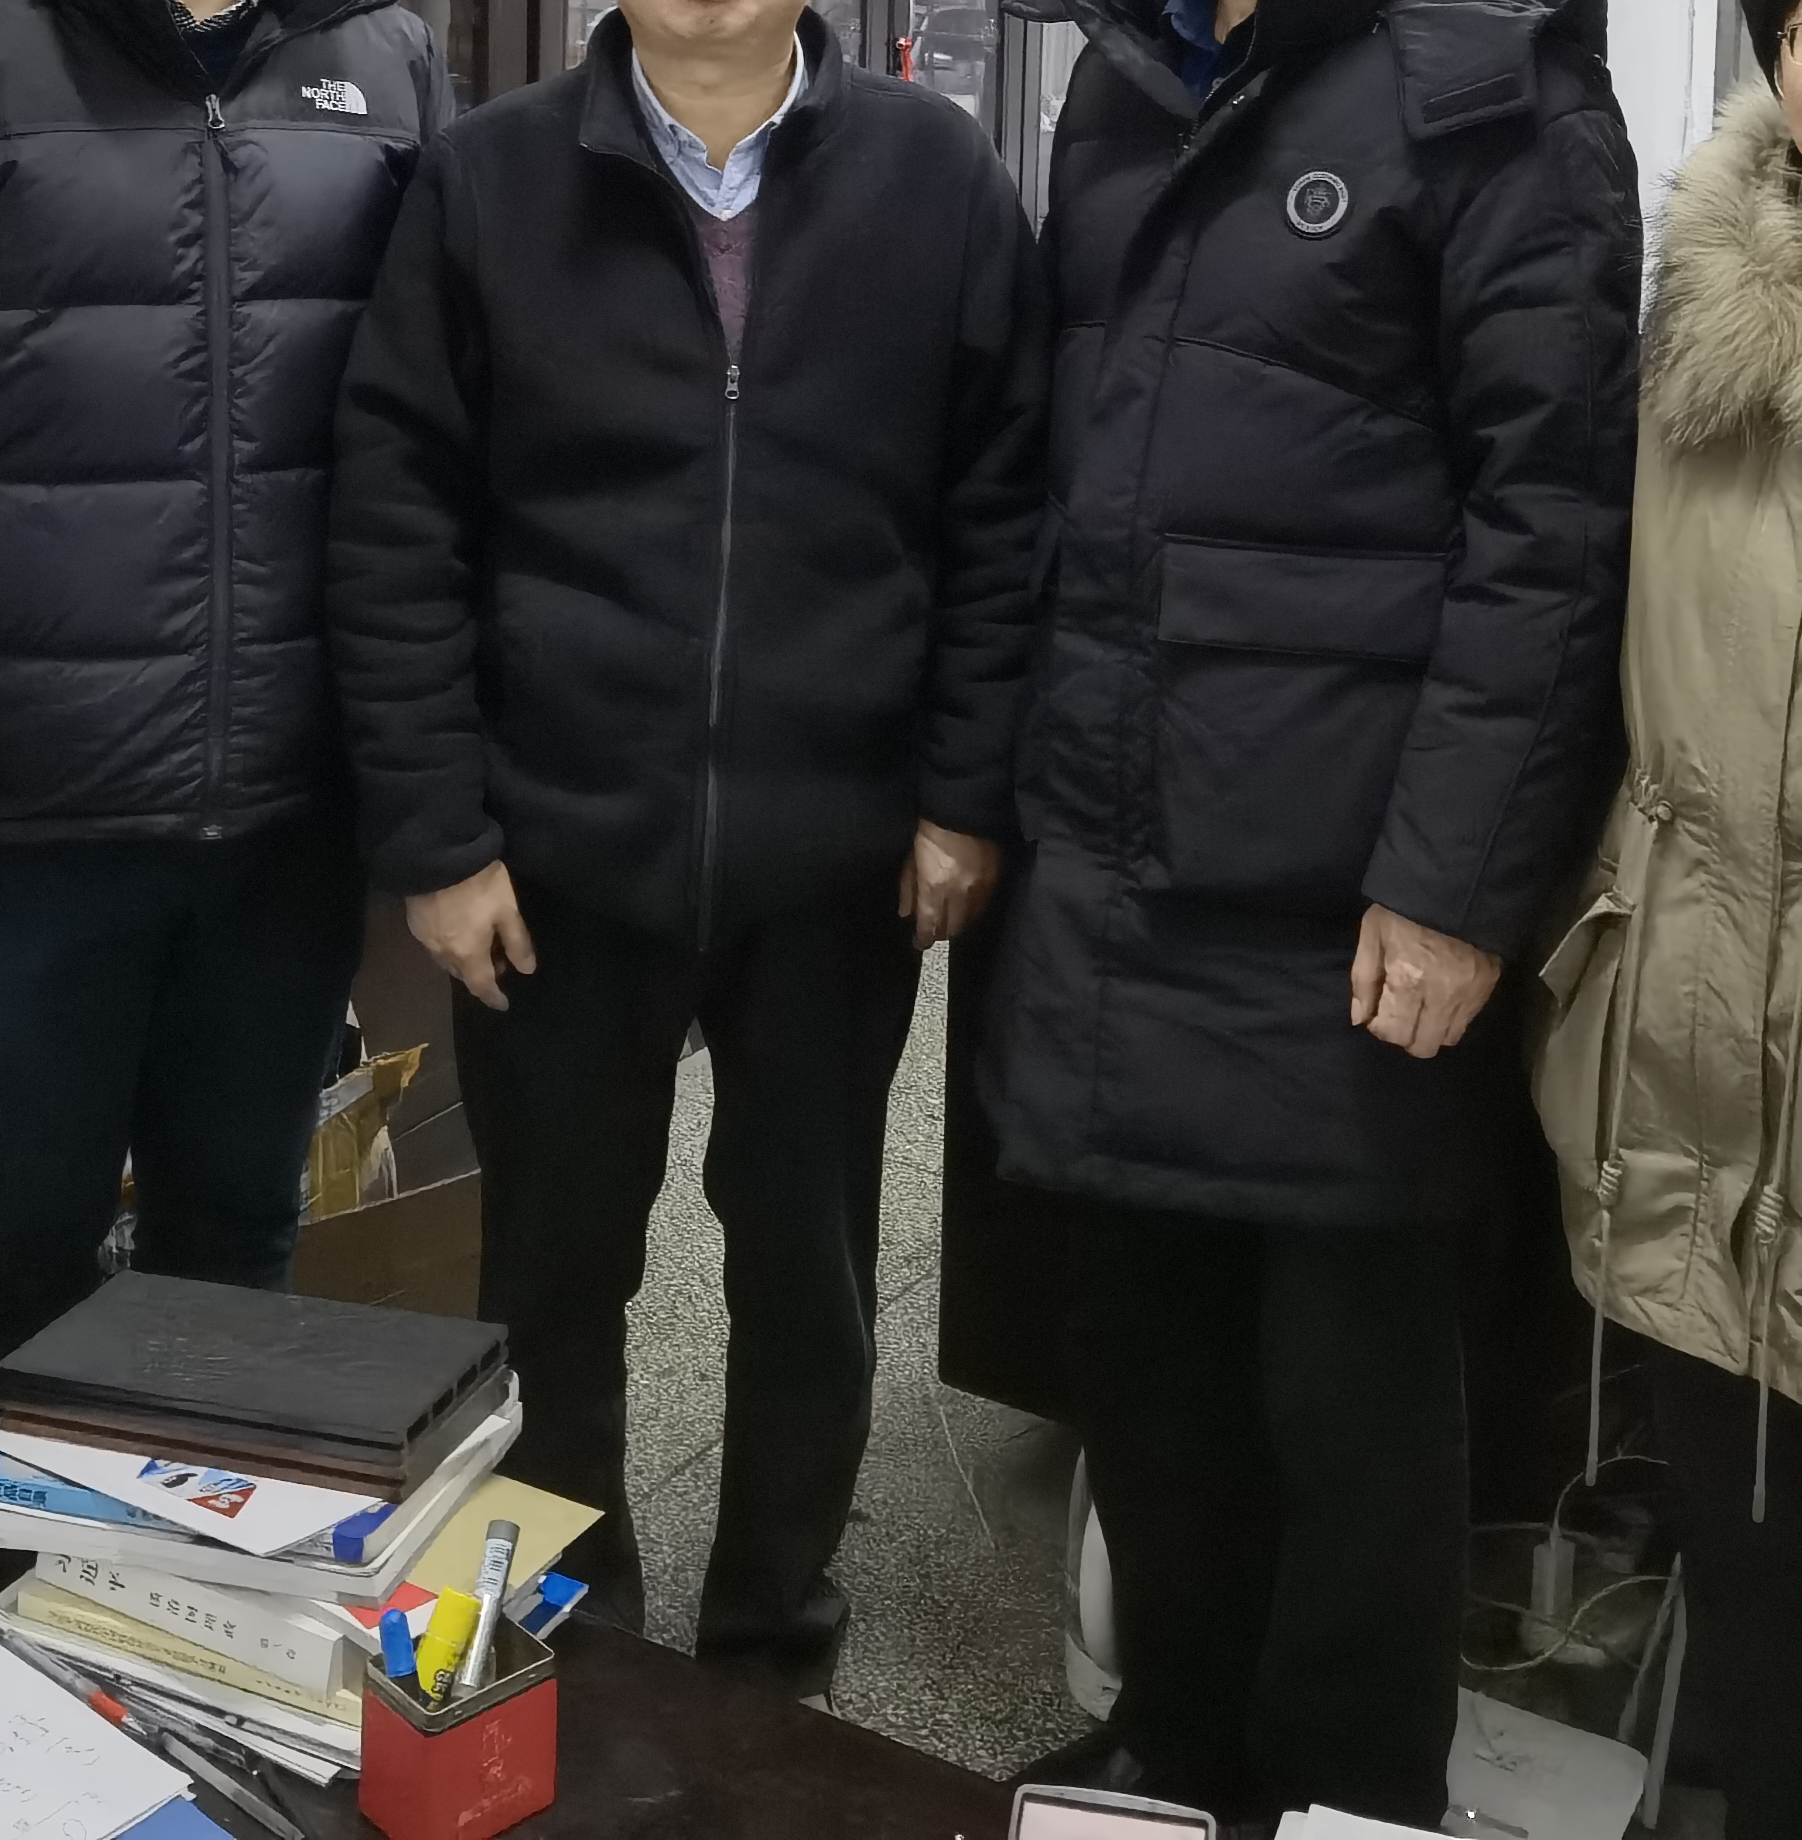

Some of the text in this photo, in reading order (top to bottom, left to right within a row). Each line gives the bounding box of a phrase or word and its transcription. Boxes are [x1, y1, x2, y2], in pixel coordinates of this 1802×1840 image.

[320, 78, 346, 92] THE
[301, 86, 346, 102] NORTH
[315, 98, 347, 112] FACE
